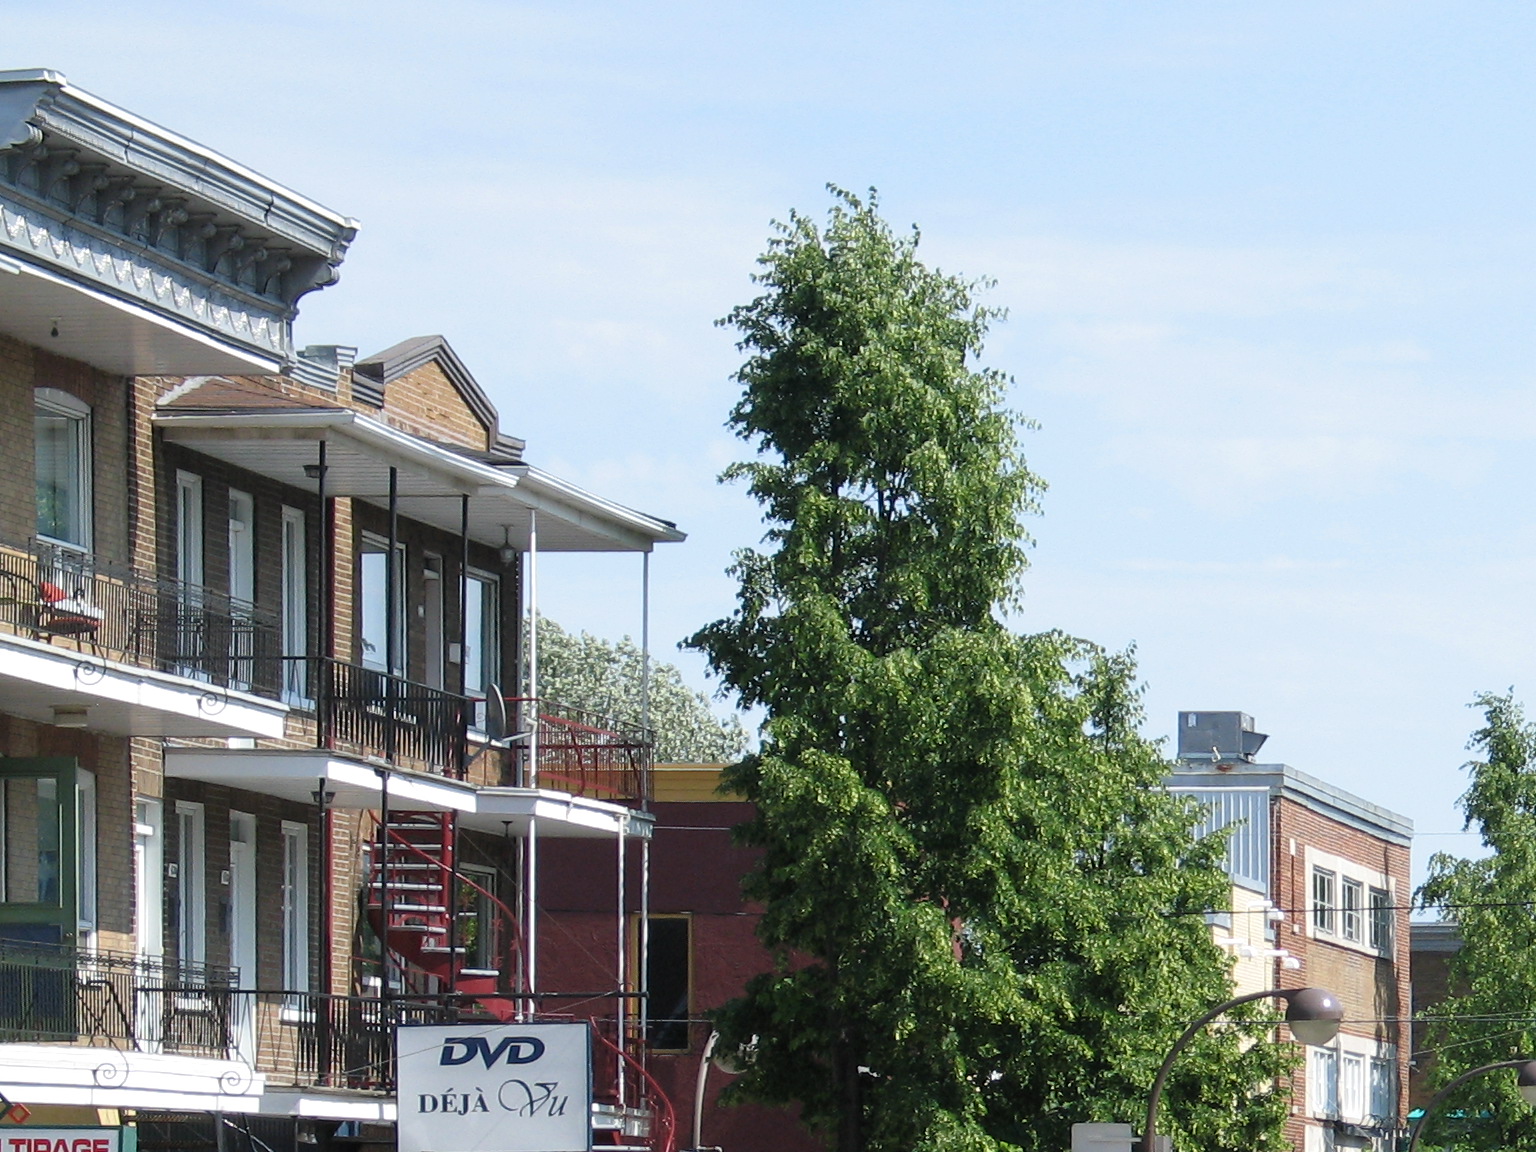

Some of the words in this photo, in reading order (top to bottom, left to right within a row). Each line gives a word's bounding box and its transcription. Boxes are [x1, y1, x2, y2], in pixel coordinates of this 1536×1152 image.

[439, 1036, 546, 1070] DVD
[417, 1086, 490, 1116] DÉJÀ
[497, 1079, 569, 1118] Vu
